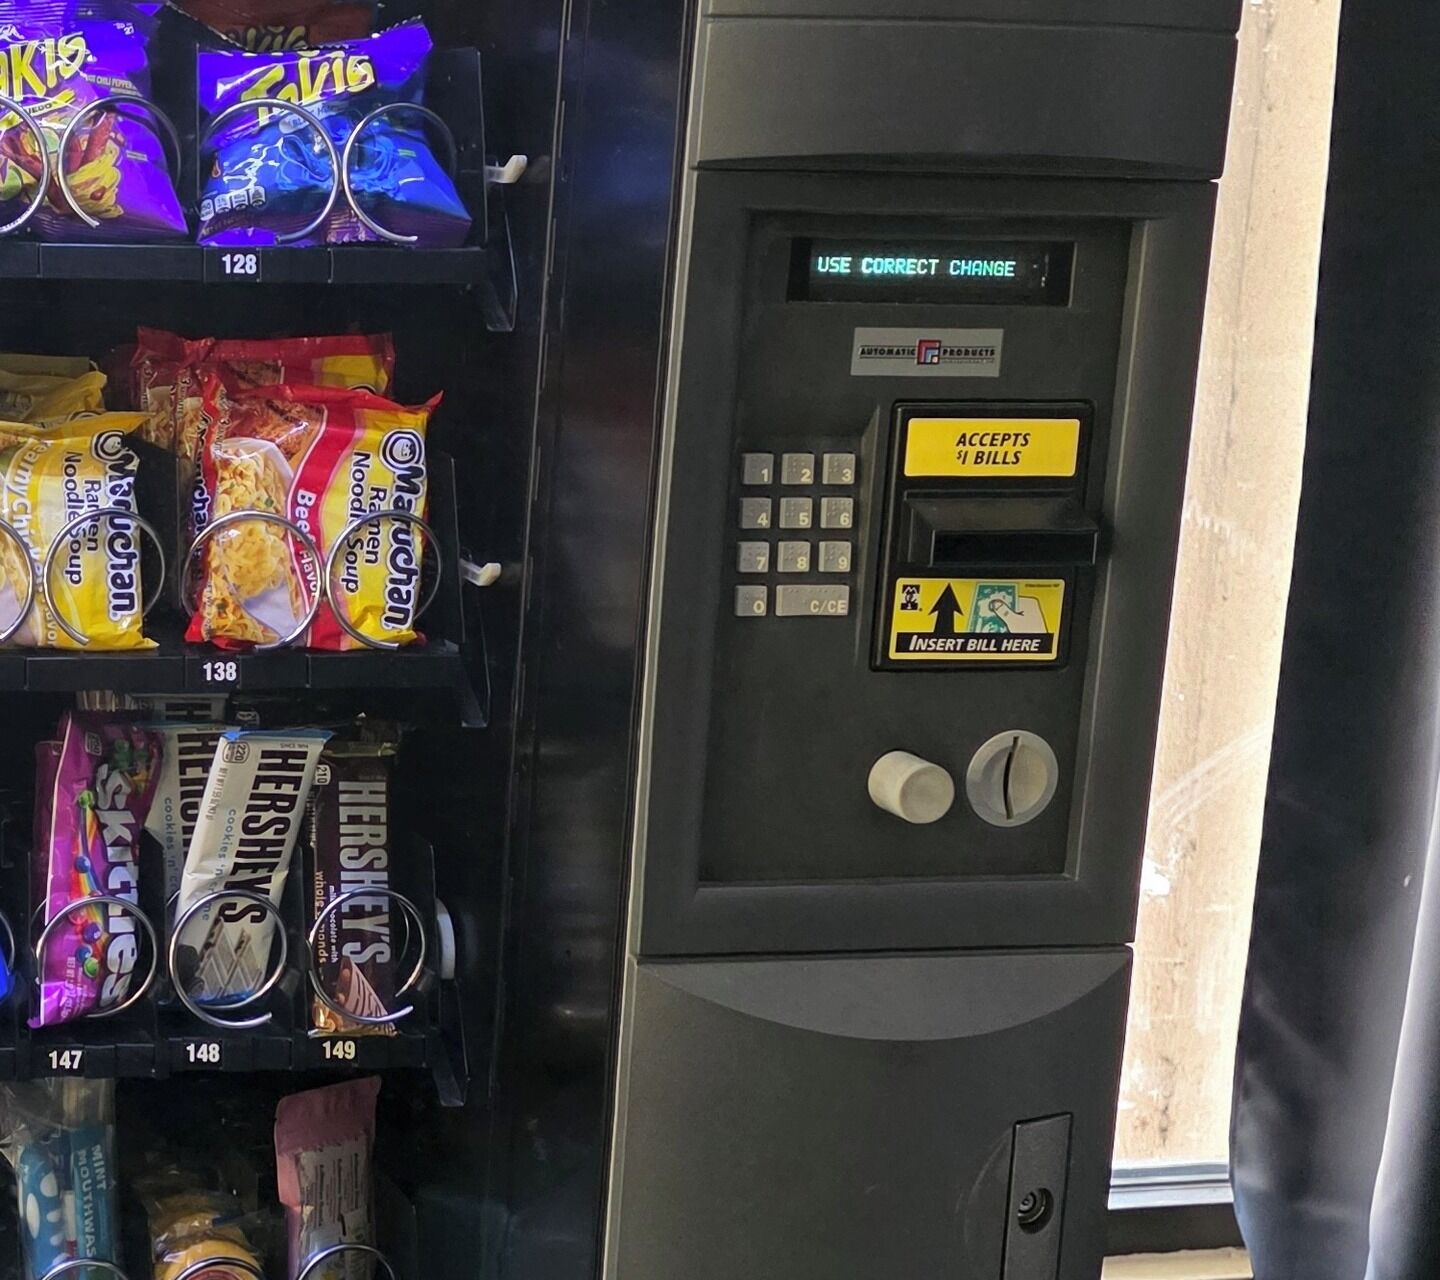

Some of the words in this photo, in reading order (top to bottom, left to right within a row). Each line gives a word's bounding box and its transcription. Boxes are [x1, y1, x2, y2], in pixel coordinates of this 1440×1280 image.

[221, 253, 258, 274] 128
[817, 256, 852, 274] USE
[861, 257, 940, 276] CORRECT
[949, 259, 1017, 278] CHANGE
[860, 347, 916, 357] AUTOMATIC
[942, 348, 996, 357] PRODUCTS
[956, 431, 1032, 448] ACCEPTS
[973, 450, 1023, 466] BILLS
[760, 468, 770, 483] 1
[799, 468, 812, 483] 2
[841, 468, 852, 483] 3
[364, 486, 388, 565] Ramen
[757, 512, 768, 526] 4
[798, 512, 810, 526] 5
[839, 512, 850, 526] 6
[103, 442, 140, 622] Maruchan
[382, 464, 427, 630] Maruchan
[340, 536, 364, 594] Soup
[755, 556, 766, 570] 7
[796, 556, 808, 570] 8
[837, 556, 849, 570] 9
[810, 599, 848, 615] C/CE
[909, 634, 965, 652] INSERT
[966, 638, 998, 652] BILL
[1001, 639, 1042, 652] HERE
[202, 661, 237, 682] 138
[234, 743, 248, 764] 220
[163, 797, 175, 853] cookies
[217, 808, 237, 862] cookies
[216, 748, 309, 926] HERSHEY'S
[337, 779, 393, 966] HERSHEY'S
[48, 1048, 83, 1070] 147
[185, 1042, 220, 1063] 148
[322, 1039, 357, 1060] 149
[89, 1142, 104, 1192] MINT
[75, 1149, 98, 1272] MOUTHWAS
